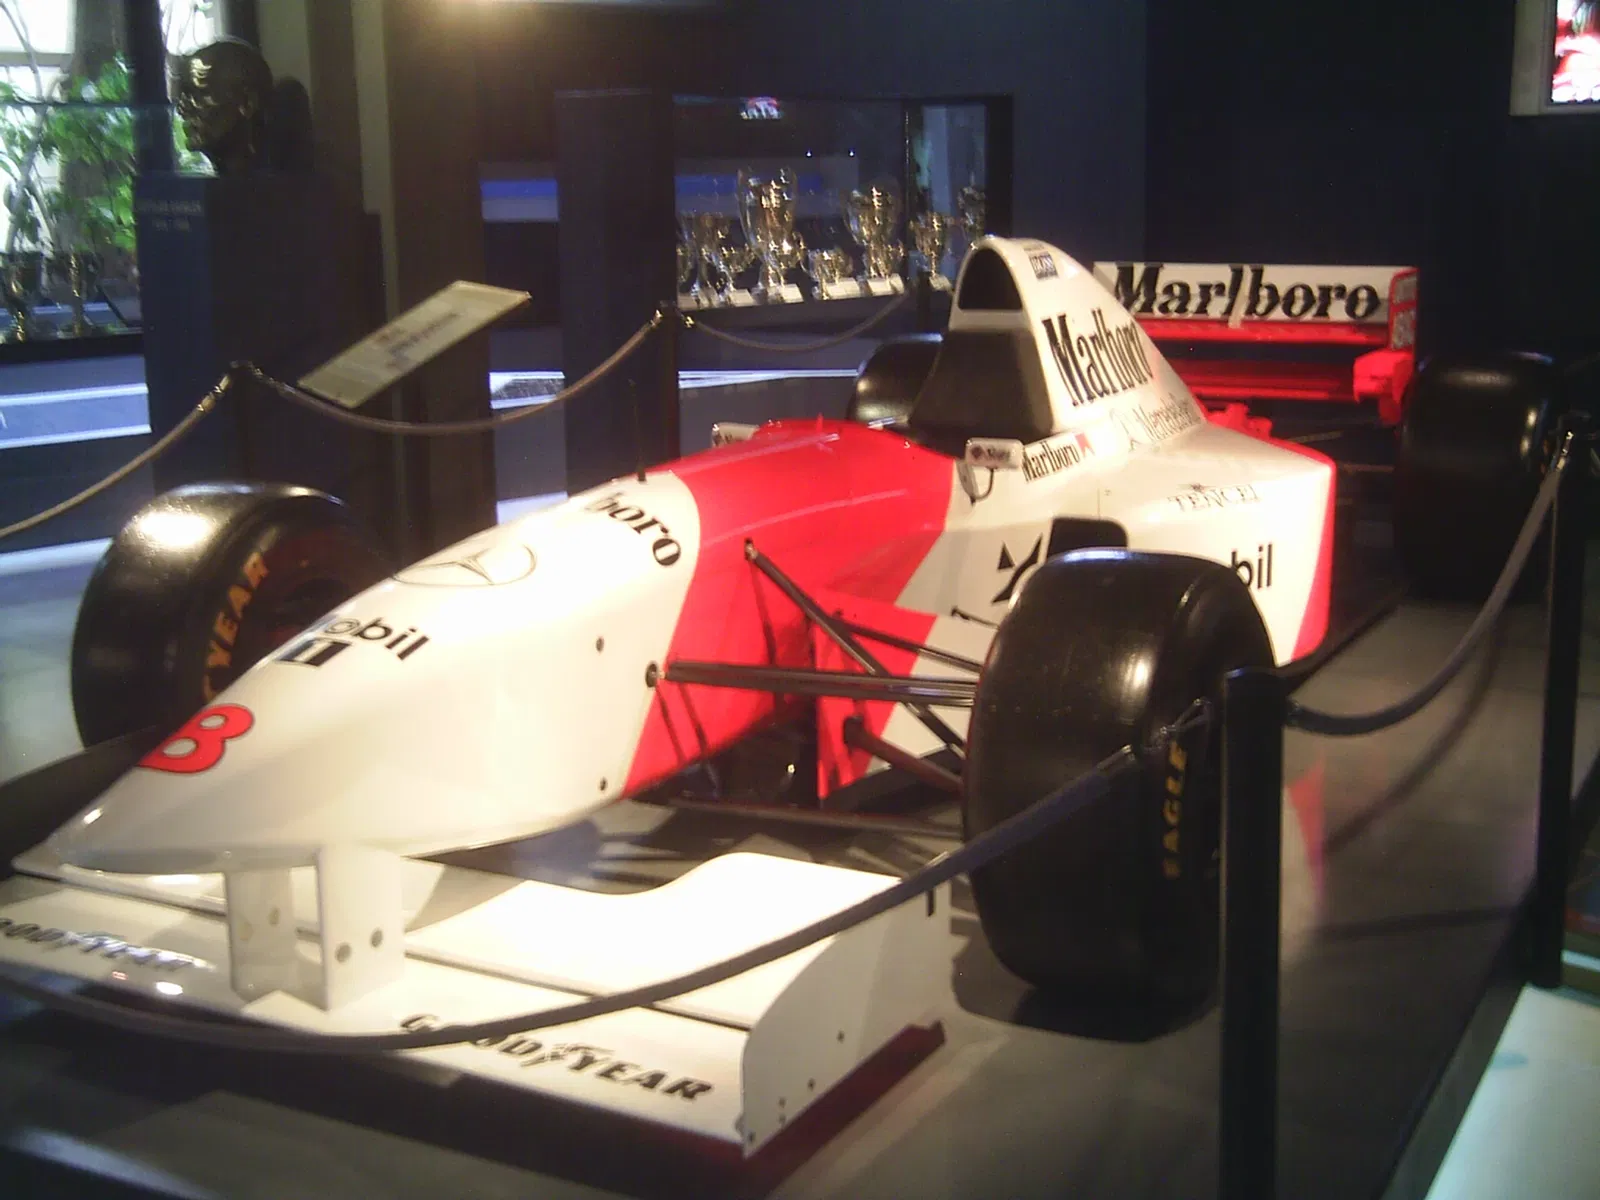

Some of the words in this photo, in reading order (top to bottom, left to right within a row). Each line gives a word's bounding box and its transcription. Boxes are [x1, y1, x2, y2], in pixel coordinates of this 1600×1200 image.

[1113, 262, 1380, 320] Marlboro
[1041, 307, 1153, 407] Marlboro
[1021, 440, 1081, 483] Marlboro
[400, 1013, 713, 1100] GDYEAR
